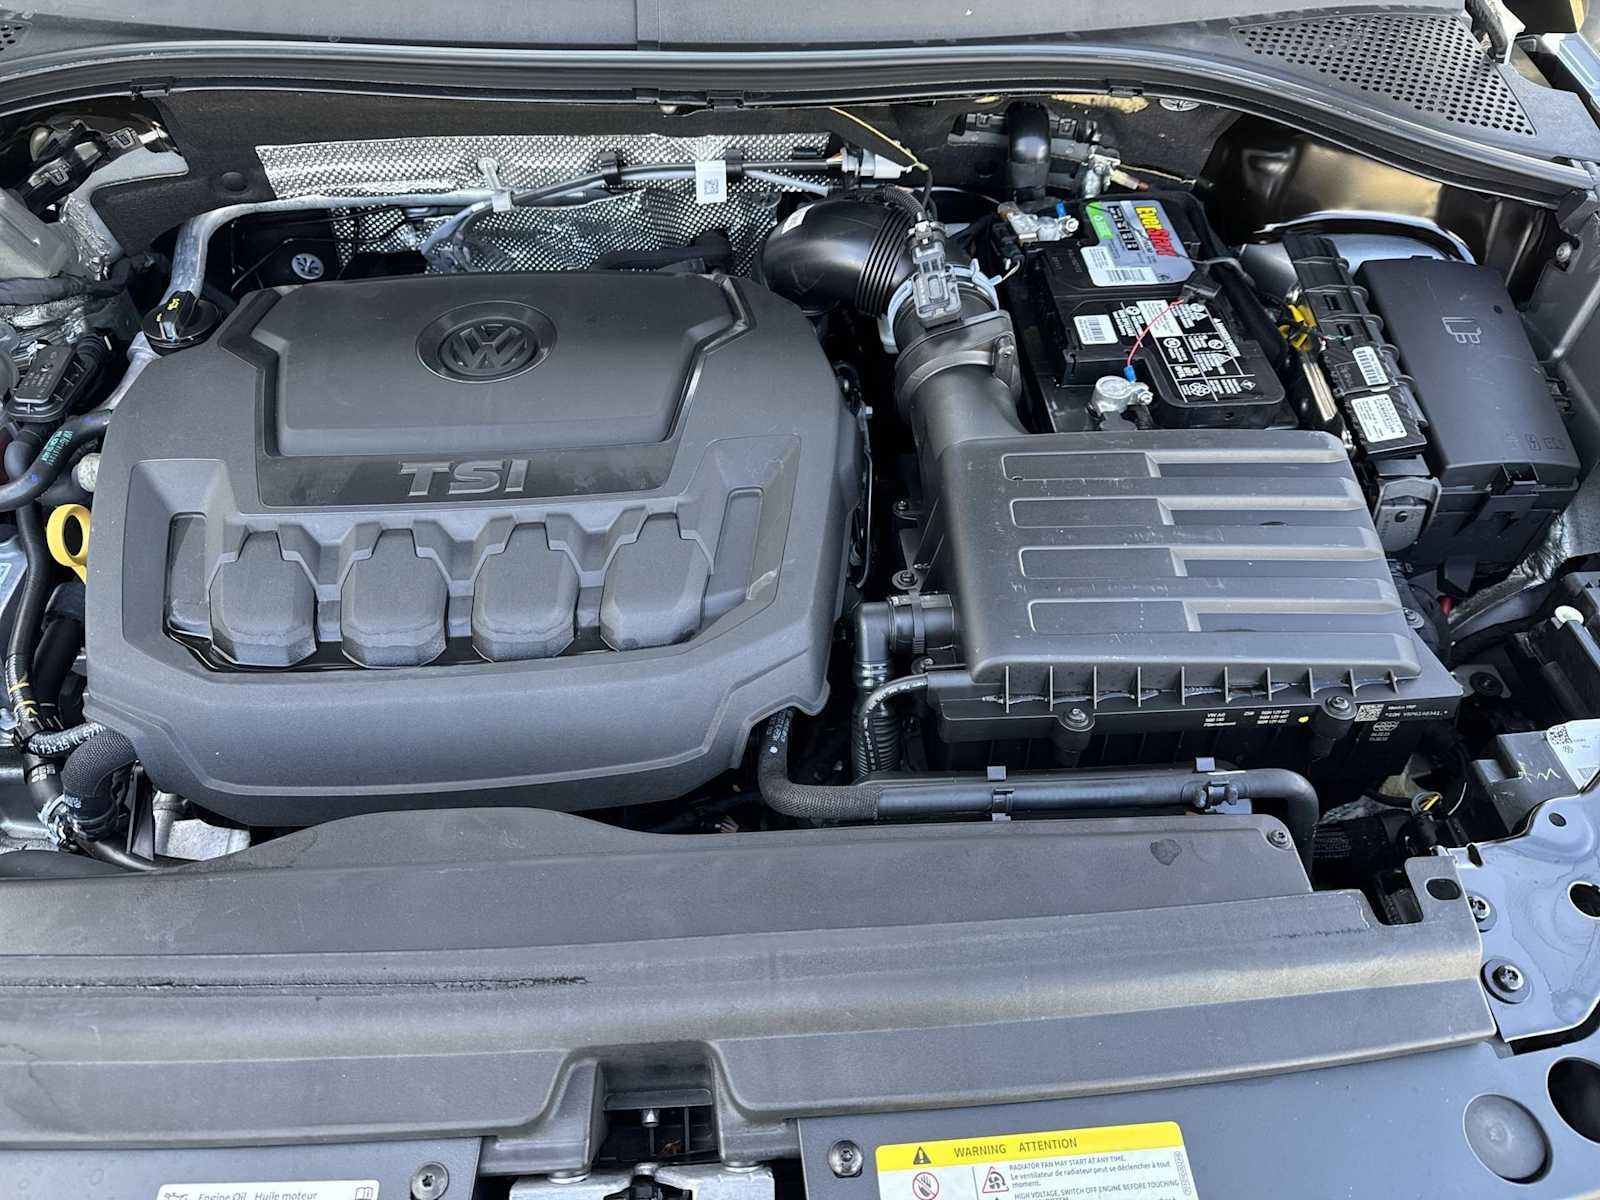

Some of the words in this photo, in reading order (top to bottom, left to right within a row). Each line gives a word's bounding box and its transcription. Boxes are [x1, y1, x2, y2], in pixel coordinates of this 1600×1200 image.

[400, 459, 531, 496] TSI
[953, 1143, 1007, 1159] WARNING
[1018, 1137, 1078, 1154] ATTENTION
[1009, 1161, 1040, 1171] RADIATOR
[1041, 1160, 1054, 1169] FAN
[1054, 1159, 1067, 1168] MAY
[1069, 1157, 1087, 1167] START
[1088, 1157, 1096, 1165] AT
[1097, 1155, 1109, 1164] ANY
[1010, 1172, 1019, 1181] Le
[1019, 1169, 1054, 1180] ventilateur
[1054, 1168, 1063, 1177] de
[1064, 1166, 1093, 1176] radiateur
[1093, 1165, 1108, 1175] peut
[1109, 1165, 1117, 1173] se
[1117, 1161, 1151, 1172] déclencher
[1156, 1159, 1171, 1168] tout
[255, 1191, 280, 1200] Huile
[281, 1191, 319, 1200] moteur
[1014, 1190, 1030, 1200] HIGH
[1060, 1186, 1084, 1197] SWITCH
[1085, 1185, 1097, 1194] OFF
[1098, 1184, 1121, 1194] ENGINE
[1122, 1181, 1147, 1192] BEFORE
[1147, 1179, 1180, 1190] TOUCHING
